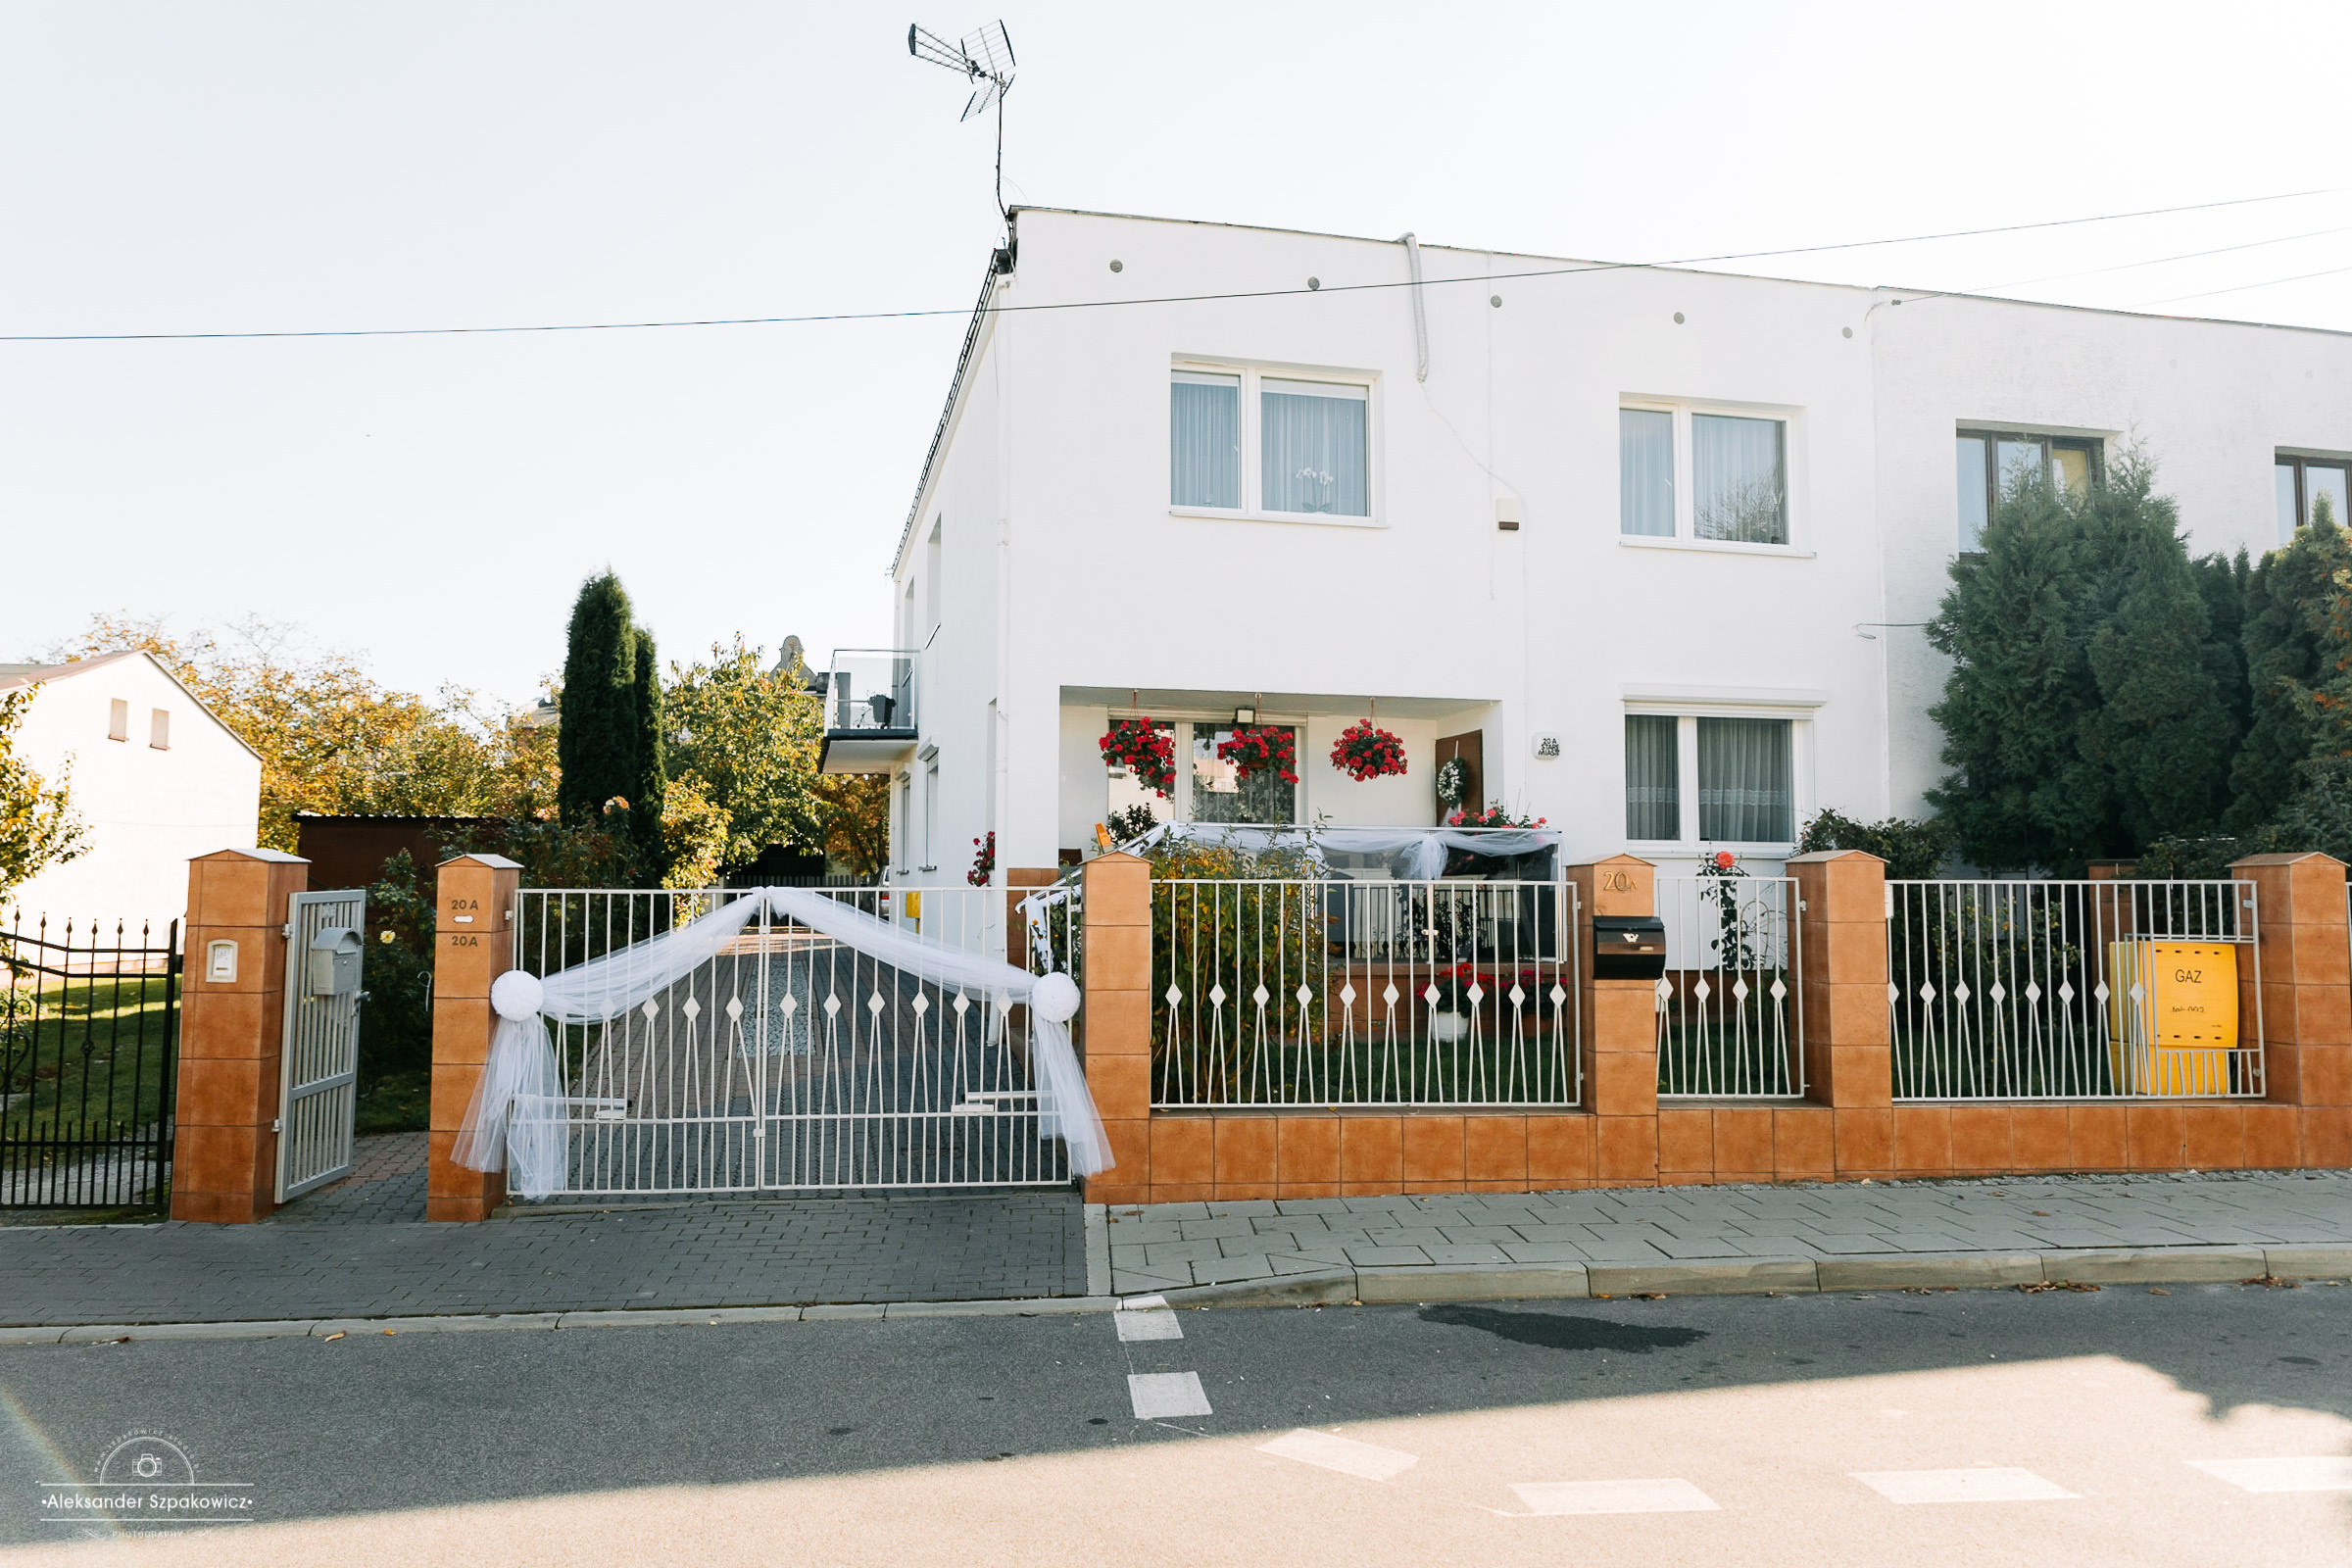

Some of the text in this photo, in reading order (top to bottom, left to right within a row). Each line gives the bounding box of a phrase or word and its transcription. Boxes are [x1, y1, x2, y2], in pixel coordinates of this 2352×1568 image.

[452, 900, 478, 910] 20 A
[2175, 968, 2202, 984] GAZ
